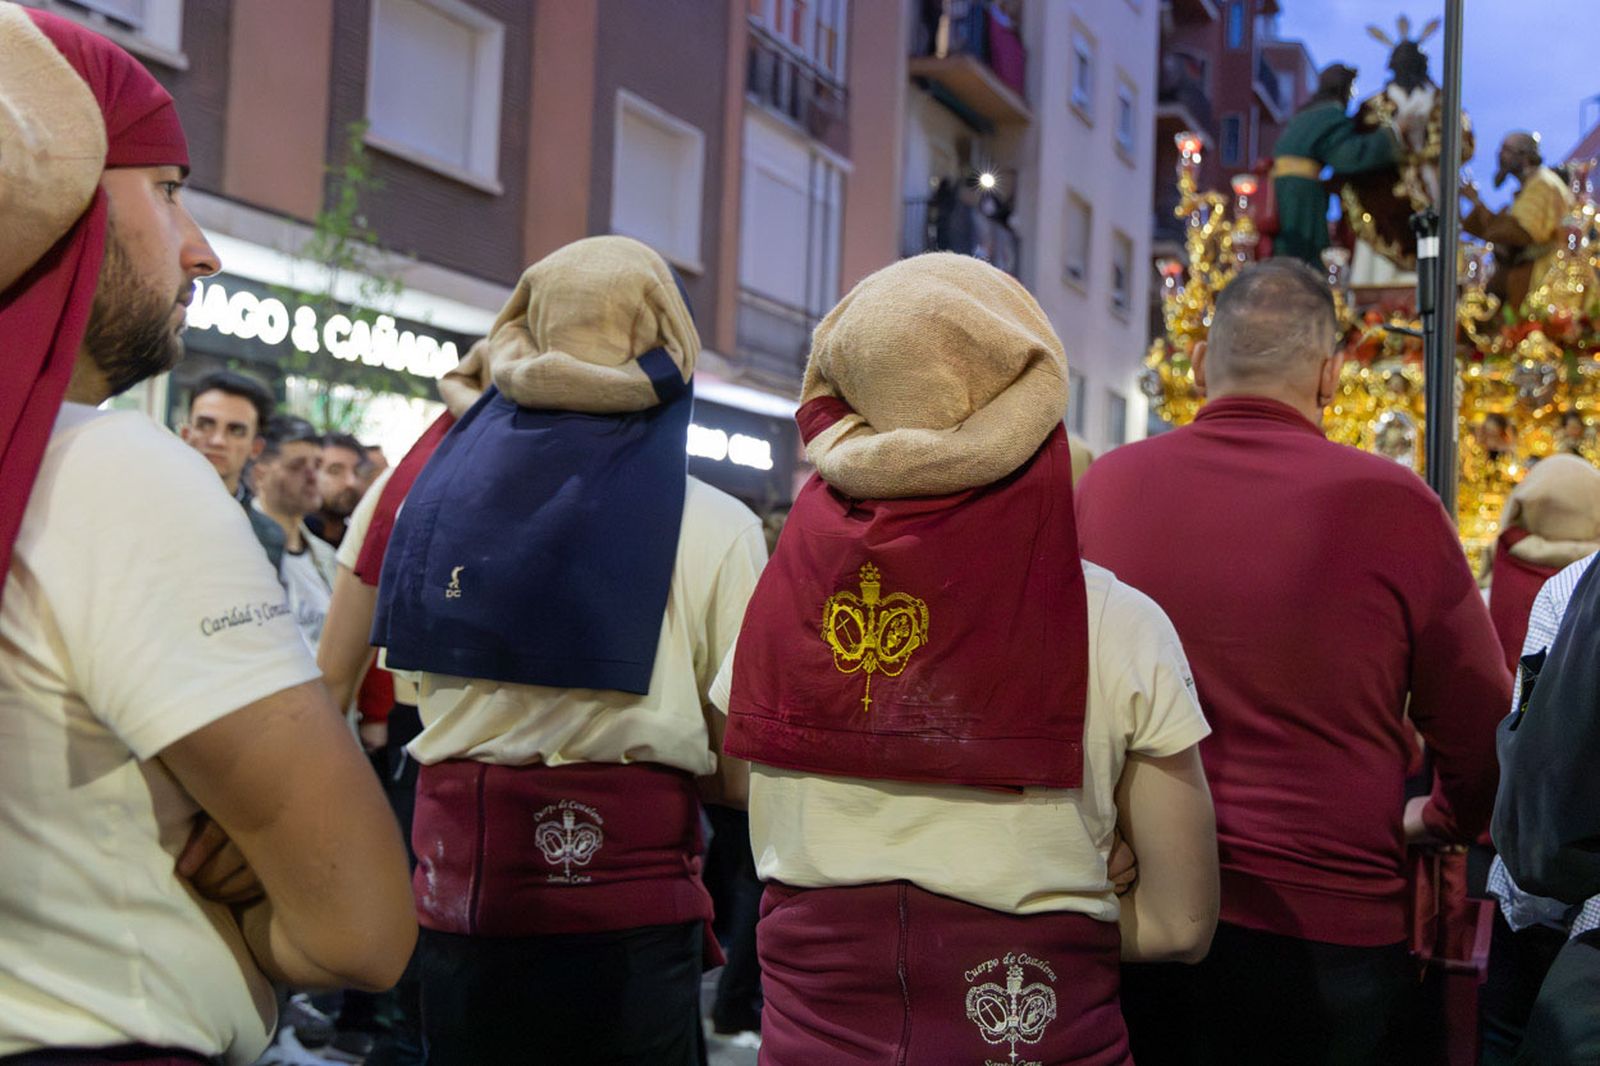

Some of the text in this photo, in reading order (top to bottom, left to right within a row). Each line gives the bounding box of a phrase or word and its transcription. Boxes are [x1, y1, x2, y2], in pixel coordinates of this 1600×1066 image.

[291, 305, 320, 353] &
[200, 603, 253, 637] Caridad
[964, 958, 999, 983] Cuerpo
[1002, 951, 1016, 964] de
